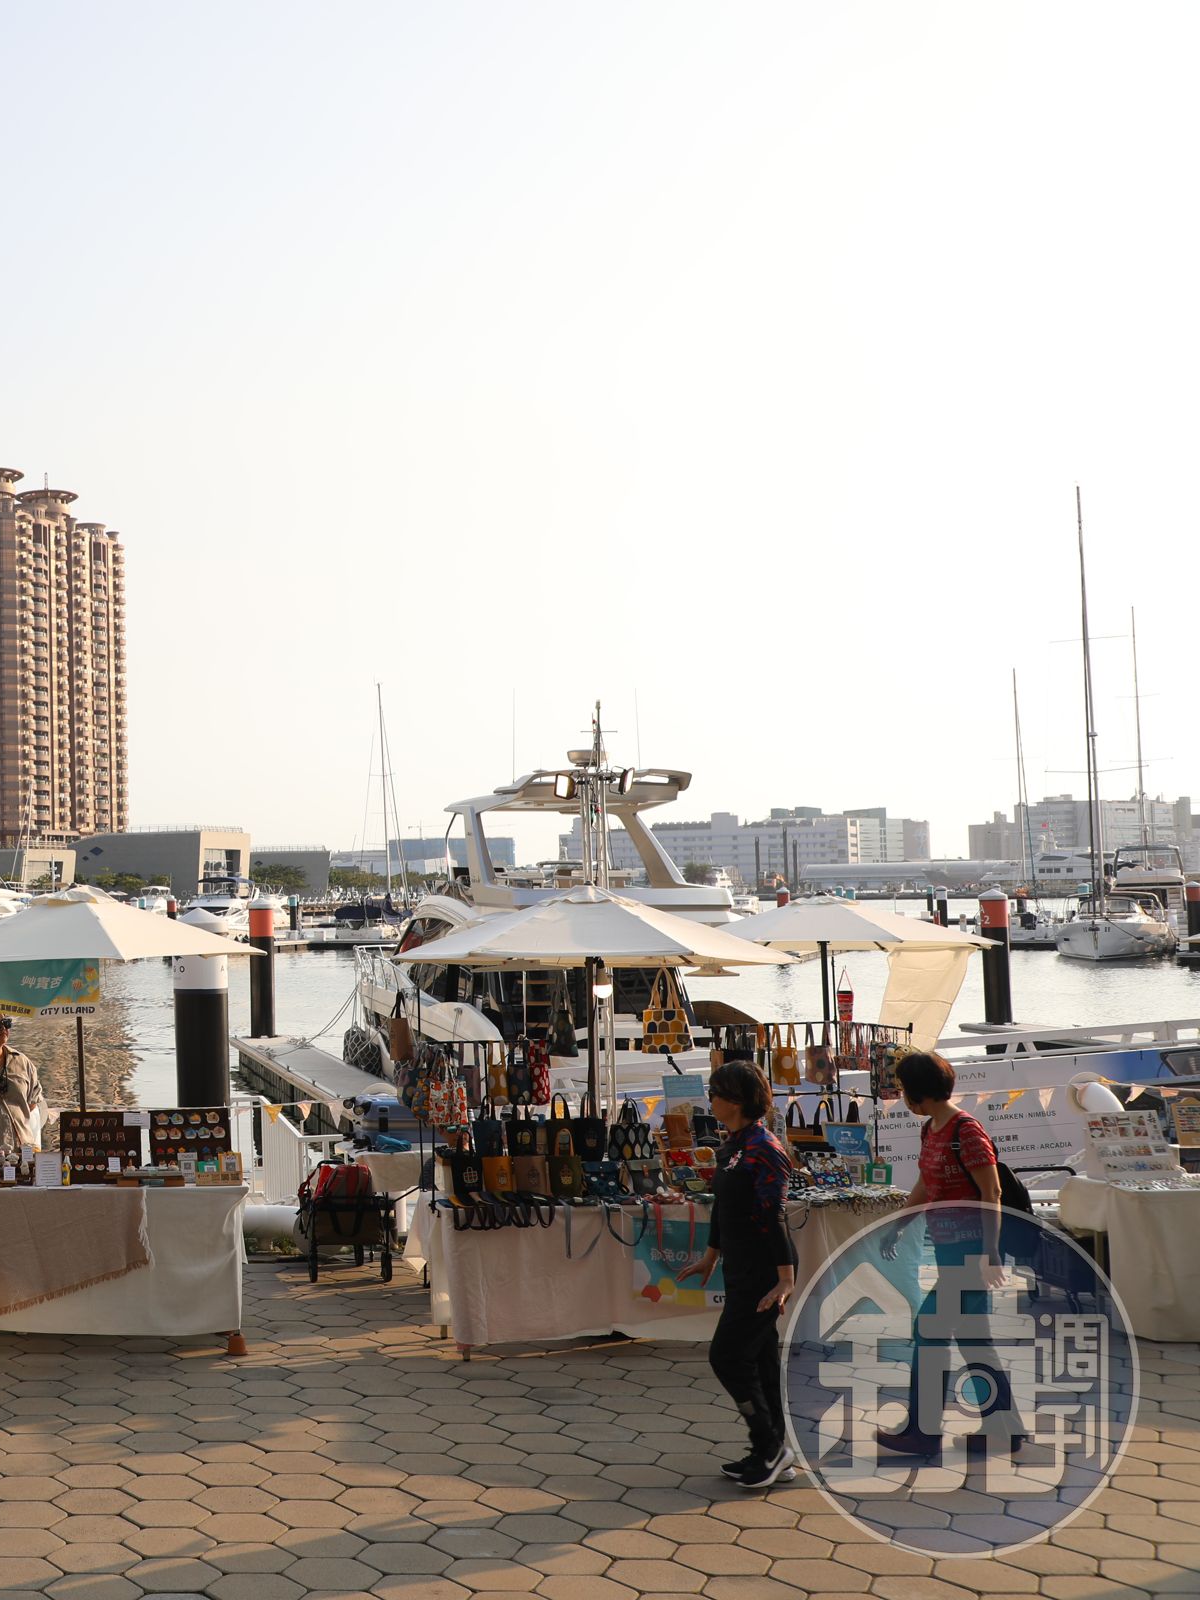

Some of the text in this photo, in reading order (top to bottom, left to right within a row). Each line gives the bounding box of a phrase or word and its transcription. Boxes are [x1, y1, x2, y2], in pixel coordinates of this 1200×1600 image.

[40, 1005, 96, 1016] CITY ISLAND
[1027, 1110, 1057, 1119] NIMBUS
[998, 1141, 1073, 1154] UNSEEKER ARCADIA
[712, 1294, 726, 1304] CIT
